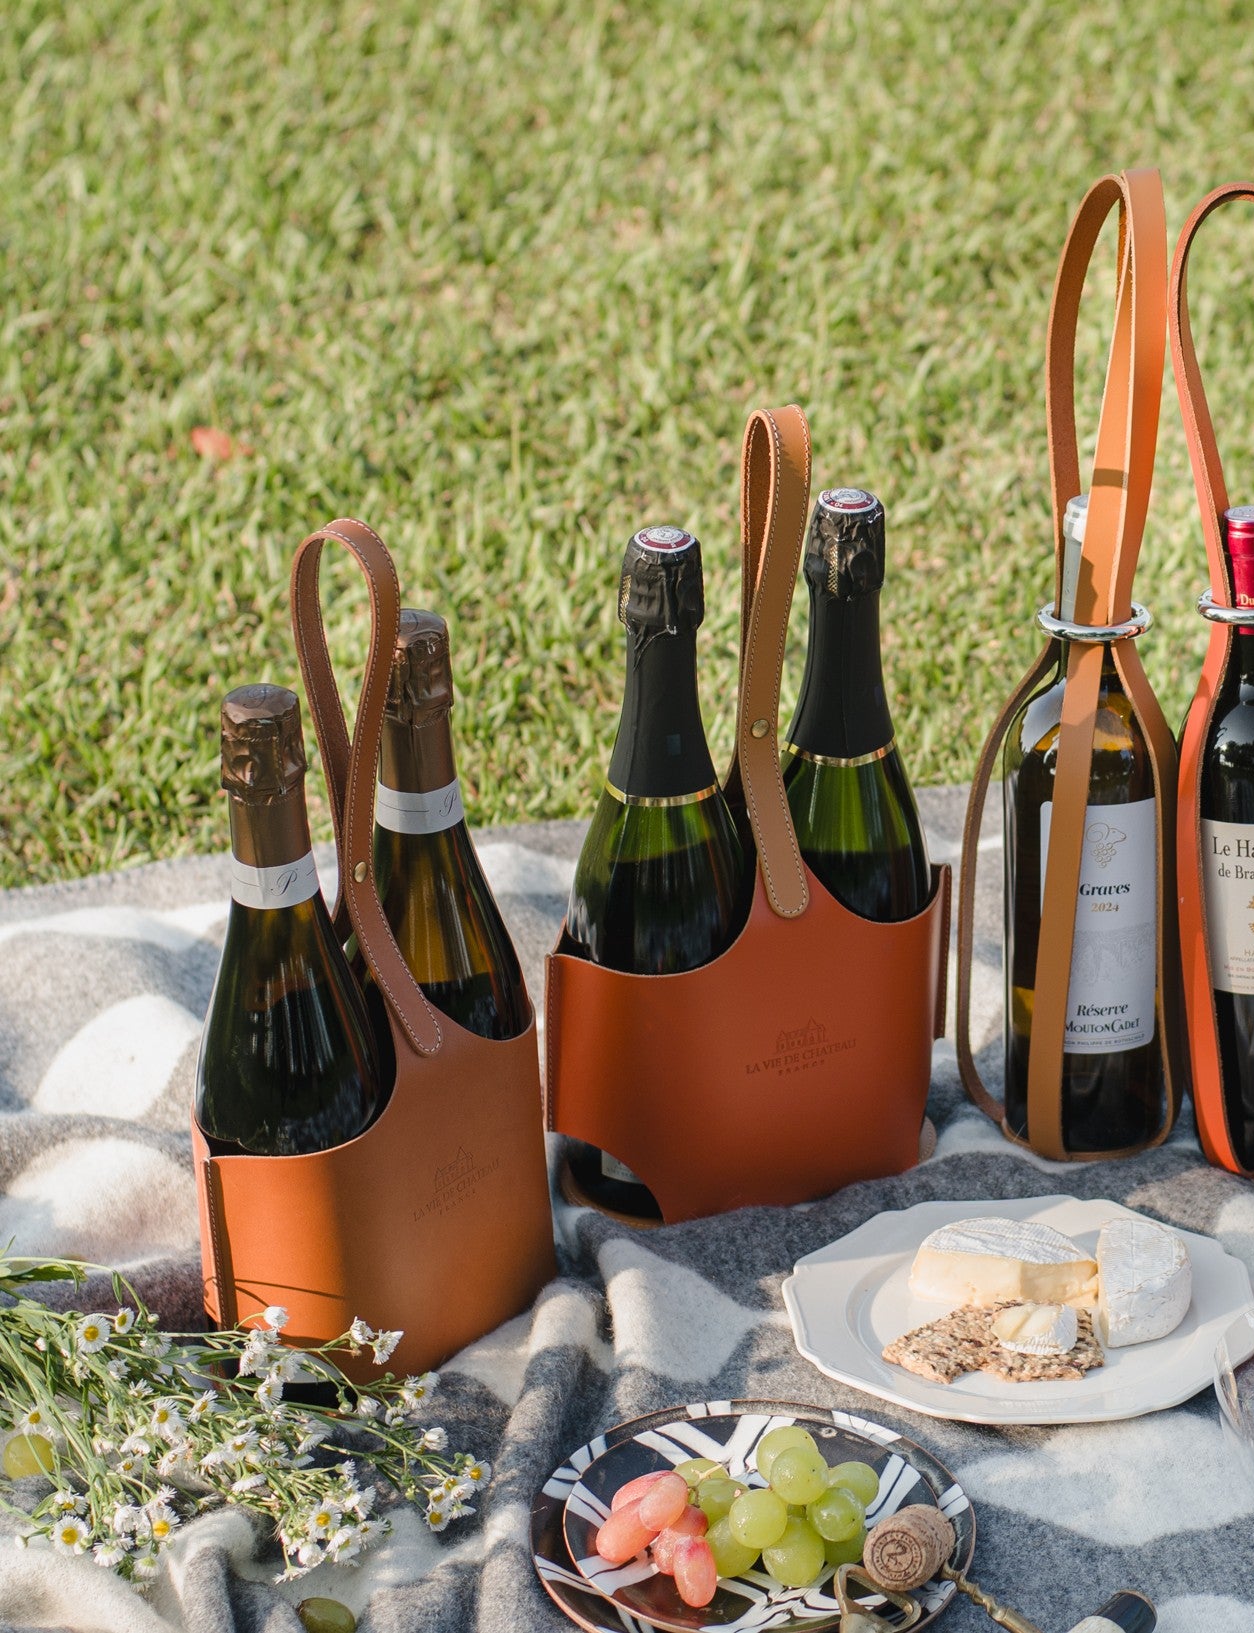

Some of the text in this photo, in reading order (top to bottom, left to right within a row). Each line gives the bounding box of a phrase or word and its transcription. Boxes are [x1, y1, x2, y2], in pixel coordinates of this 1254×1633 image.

[1212, 836, 1231, 857] Le
[1218, 862, 1231, 878] de
[1079, 882, 1131, 896] Graves
[1090, 902, 1120, 912] 2024
[1076, 1003, 1129, 1017] Réserve
[745, 1063, 760, 1074] LA
[762, 1058, 781, 1070] VIE
[784, 1053, 800, 1066] DE
